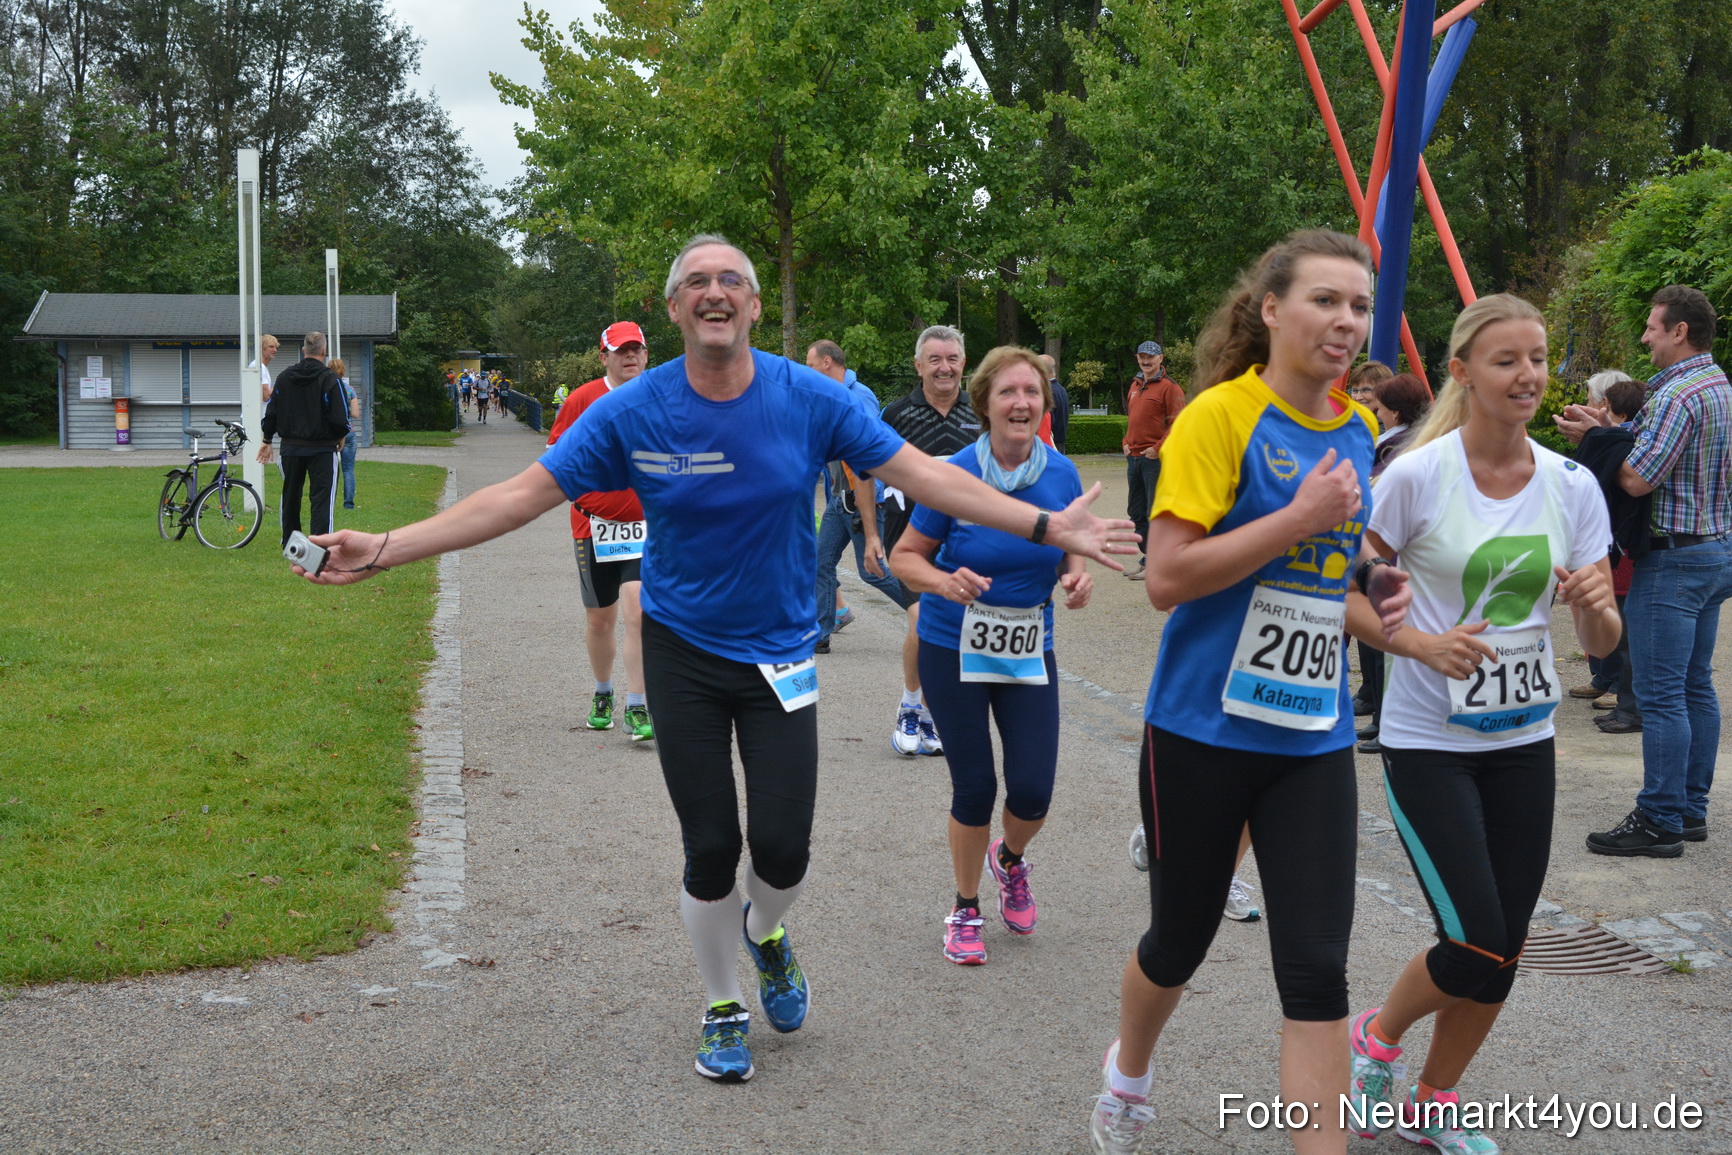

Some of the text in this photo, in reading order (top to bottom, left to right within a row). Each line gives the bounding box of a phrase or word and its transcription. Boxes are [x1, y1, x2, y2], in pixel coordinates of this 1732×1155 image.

[597, 522, 643, 541] 2756
[609, 546, 631, 554] Dieter
[968, 606, 1035, 622] PARTL Neumarkt
[1253, 600, 1339, 626] PARTL Neumarkt
[970, 622, 1039, 655] 3360
[1496, 645, 1536, 657] Neumarkt
[1249, 624, 1338, 681] 2096
[1465, 659, 1551, 707] 2134
[1253, 683, 1322, 714] Katarzyna
